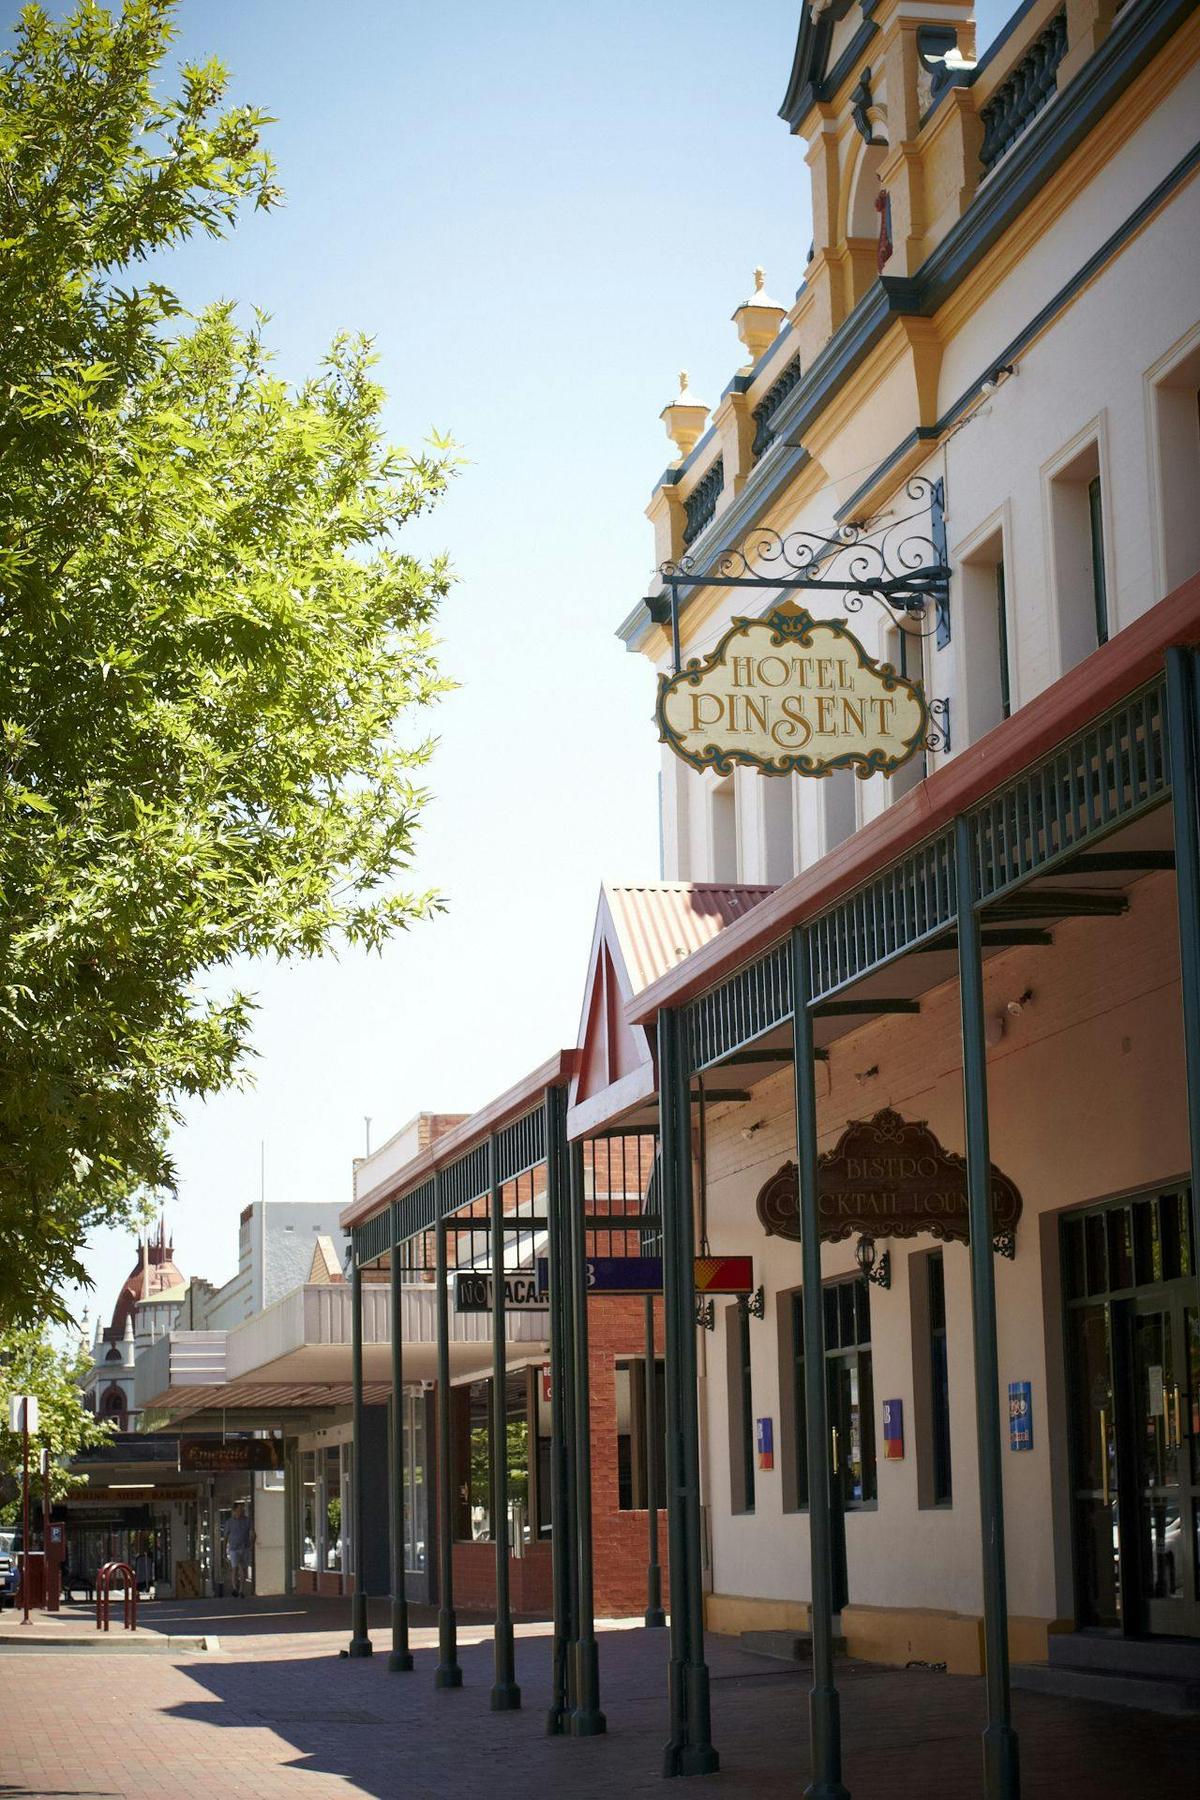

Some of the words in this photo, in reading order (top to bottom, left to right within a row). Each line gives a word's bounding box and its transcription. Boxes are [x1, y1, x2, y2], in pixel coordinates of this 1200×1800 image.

[731, 656, 854, 691] HOTEL
[688, 693, 897, 750] PINSENT
[846, 1157, 939, 1180] BISTRO
[776, 1193, 898, 1216] CCKTAIL
[912, 1192, 1004, 1214] LOUNE
[461, 1281, 487, 1304] NO
